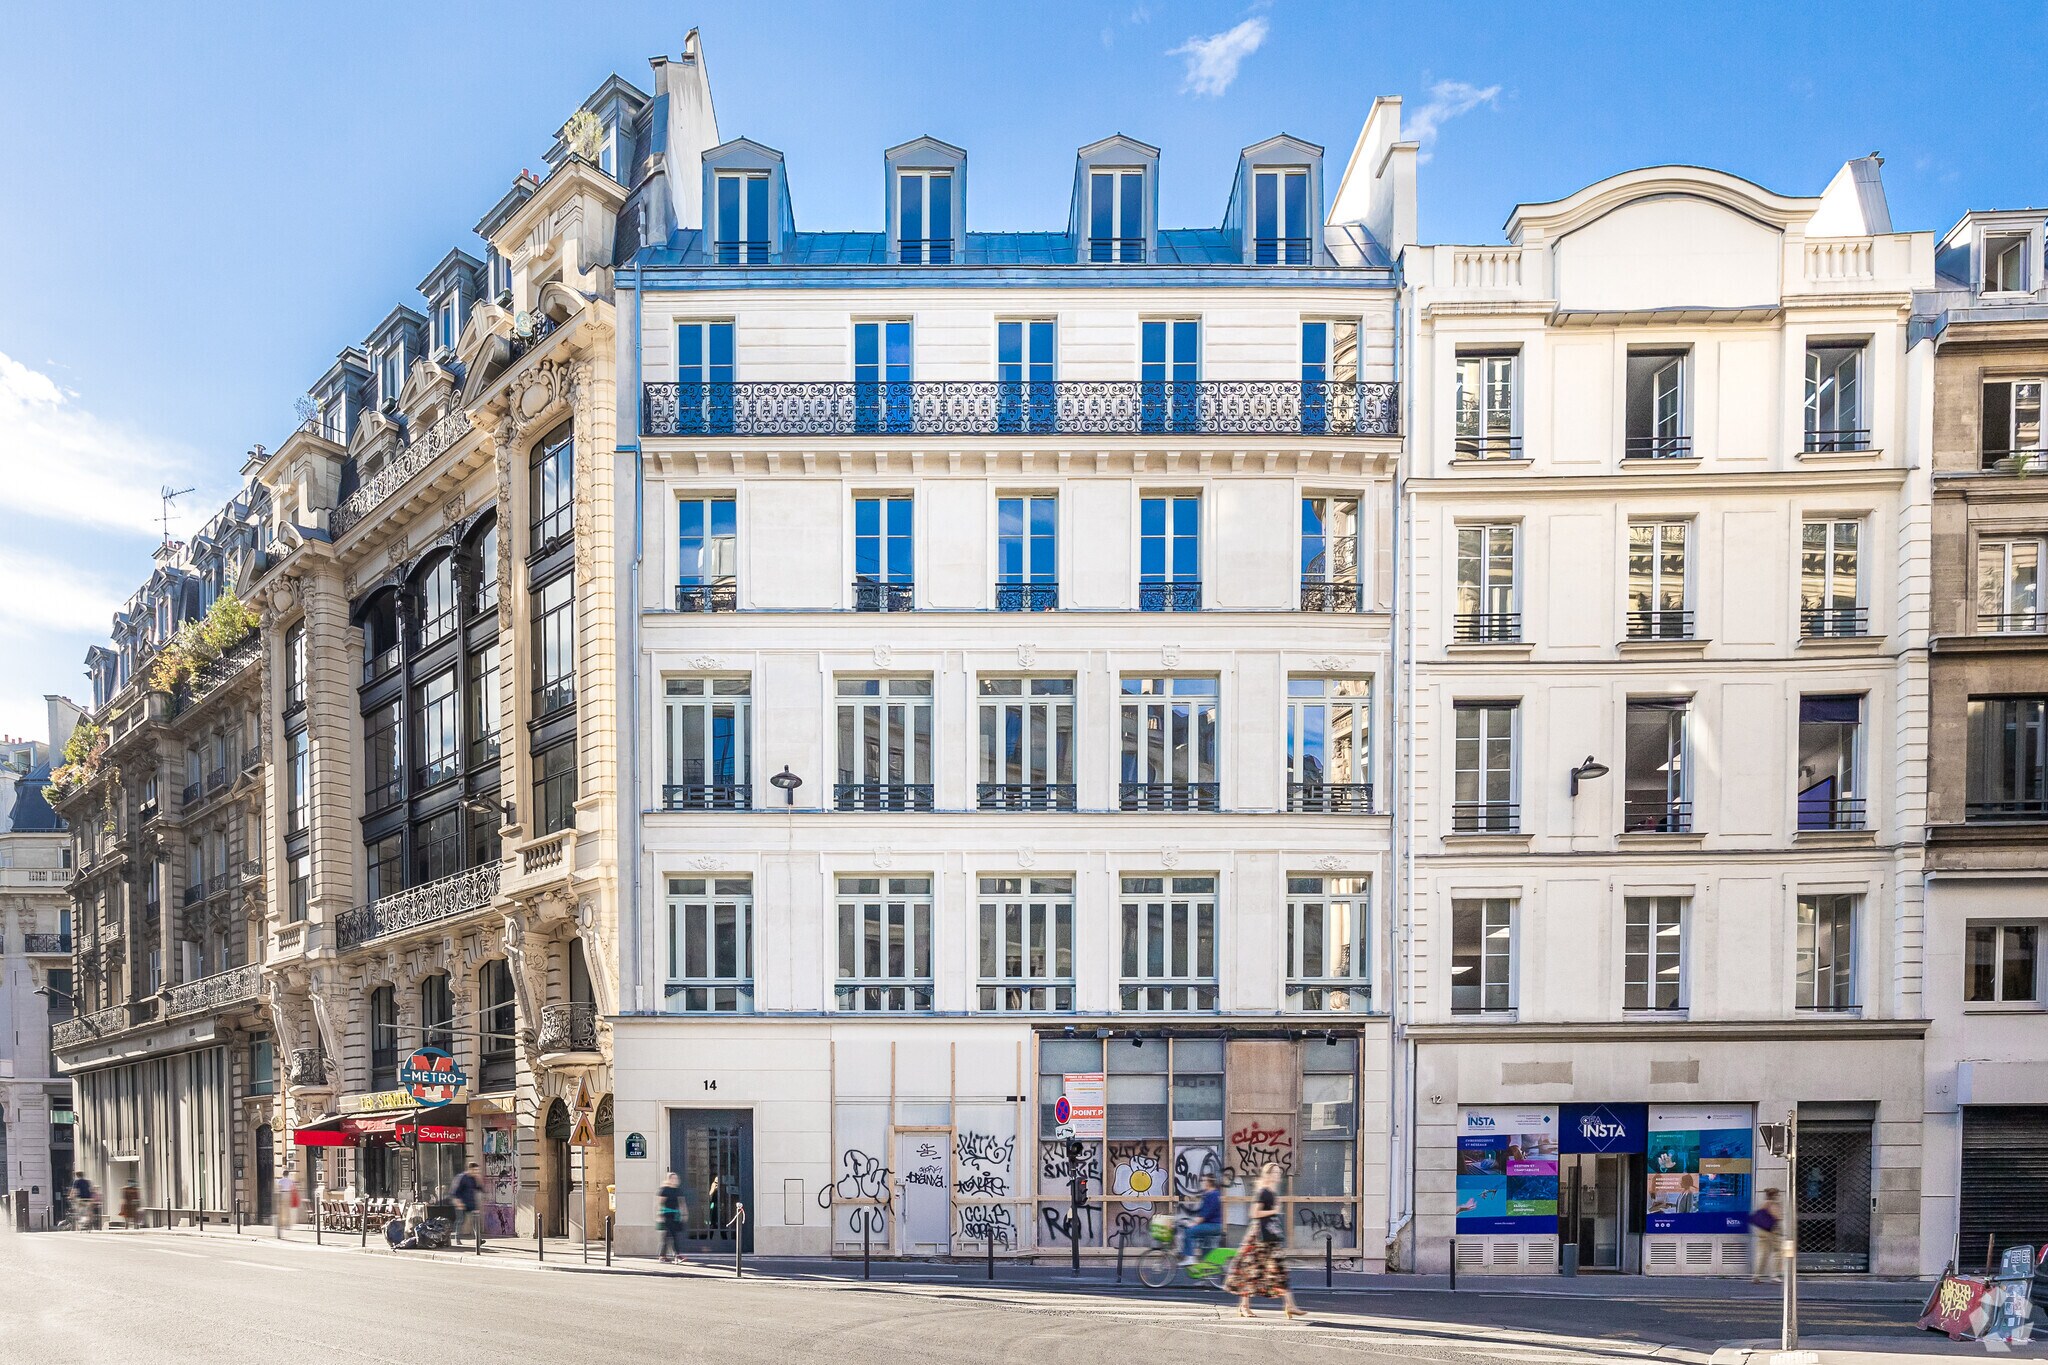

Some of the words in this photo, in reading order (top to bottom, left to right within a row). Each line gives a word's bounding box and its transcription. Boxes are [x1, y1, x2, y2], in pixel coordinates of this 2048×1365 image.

[703, 1079, 717, 1091] 14
[1467, 1116, 1496, 1126] INSTA
[420, 1127, 461, 1139] Sentier
[1583, 1124, 1626, 1138] INSTA
